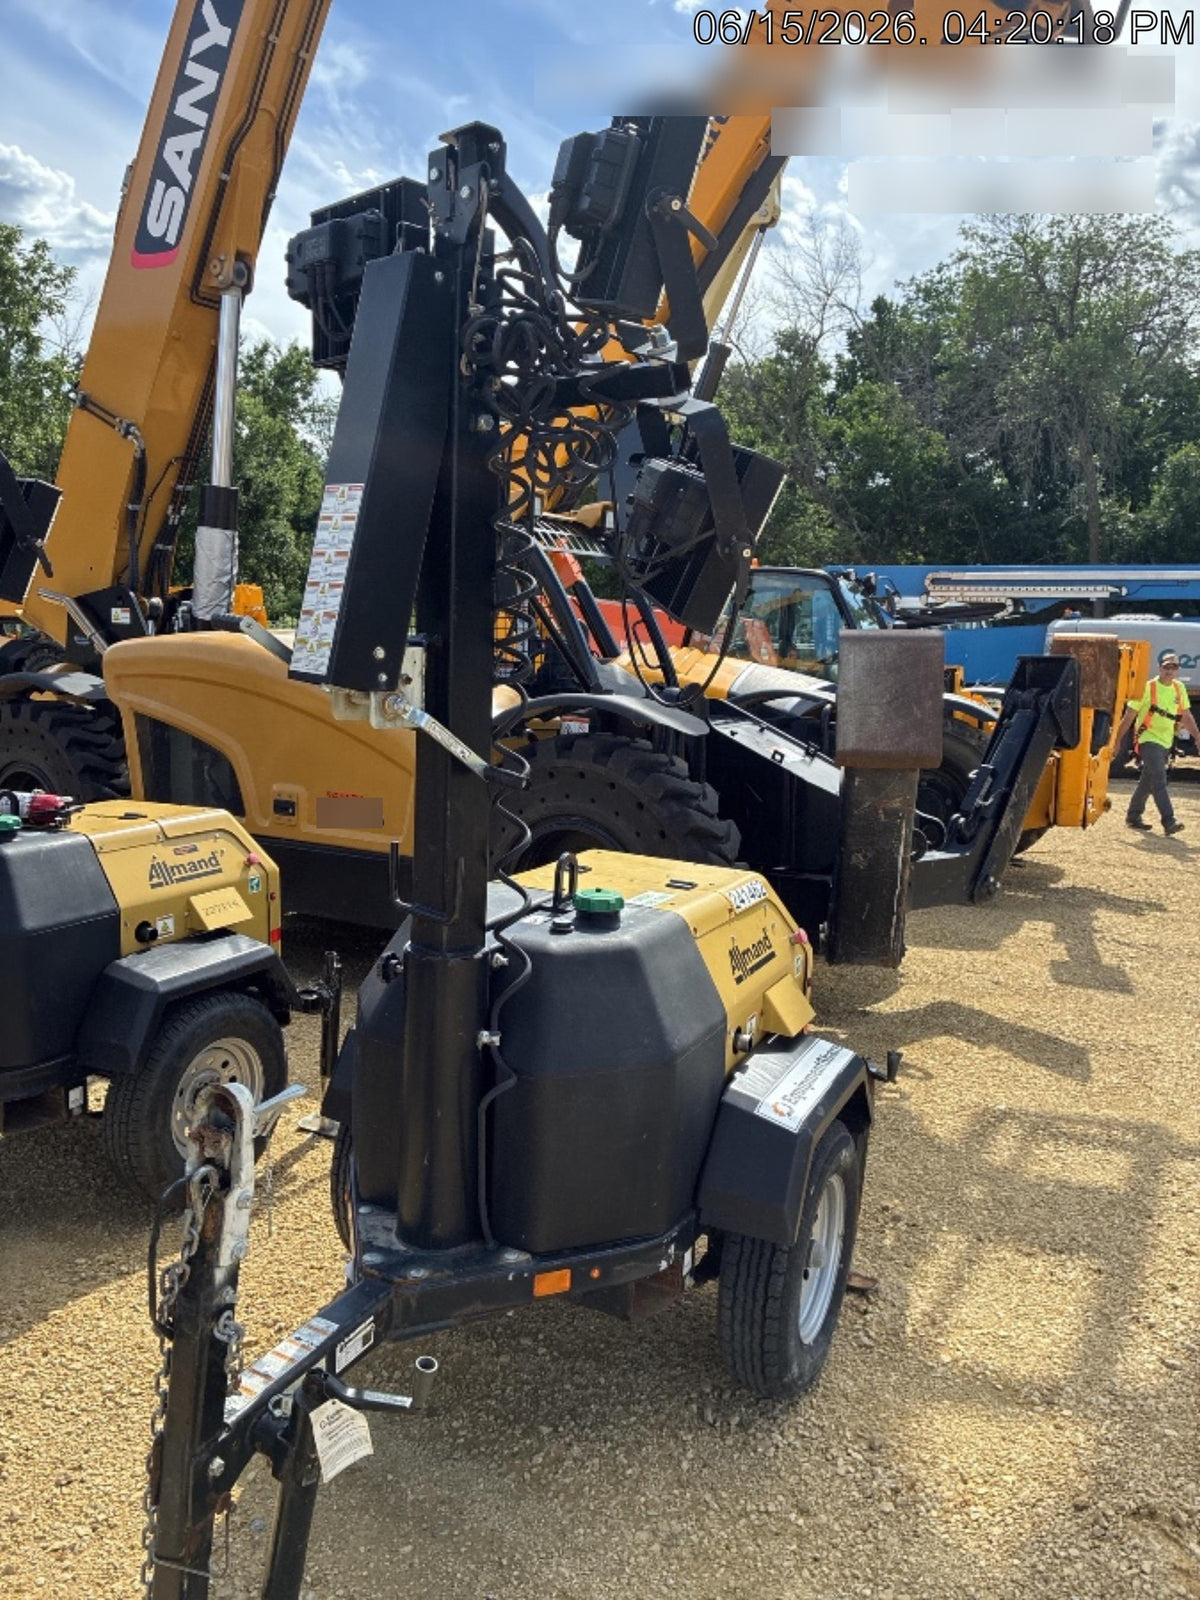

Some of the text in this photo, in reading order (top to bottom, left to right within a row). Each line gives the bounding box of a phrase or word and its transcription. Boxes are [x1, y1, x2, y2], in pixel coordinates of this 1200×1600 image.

[147, 0, 232, 246] SANY
[149, 851, 221, 886] Allmand
[729, 927, 773, 980] Allmand
